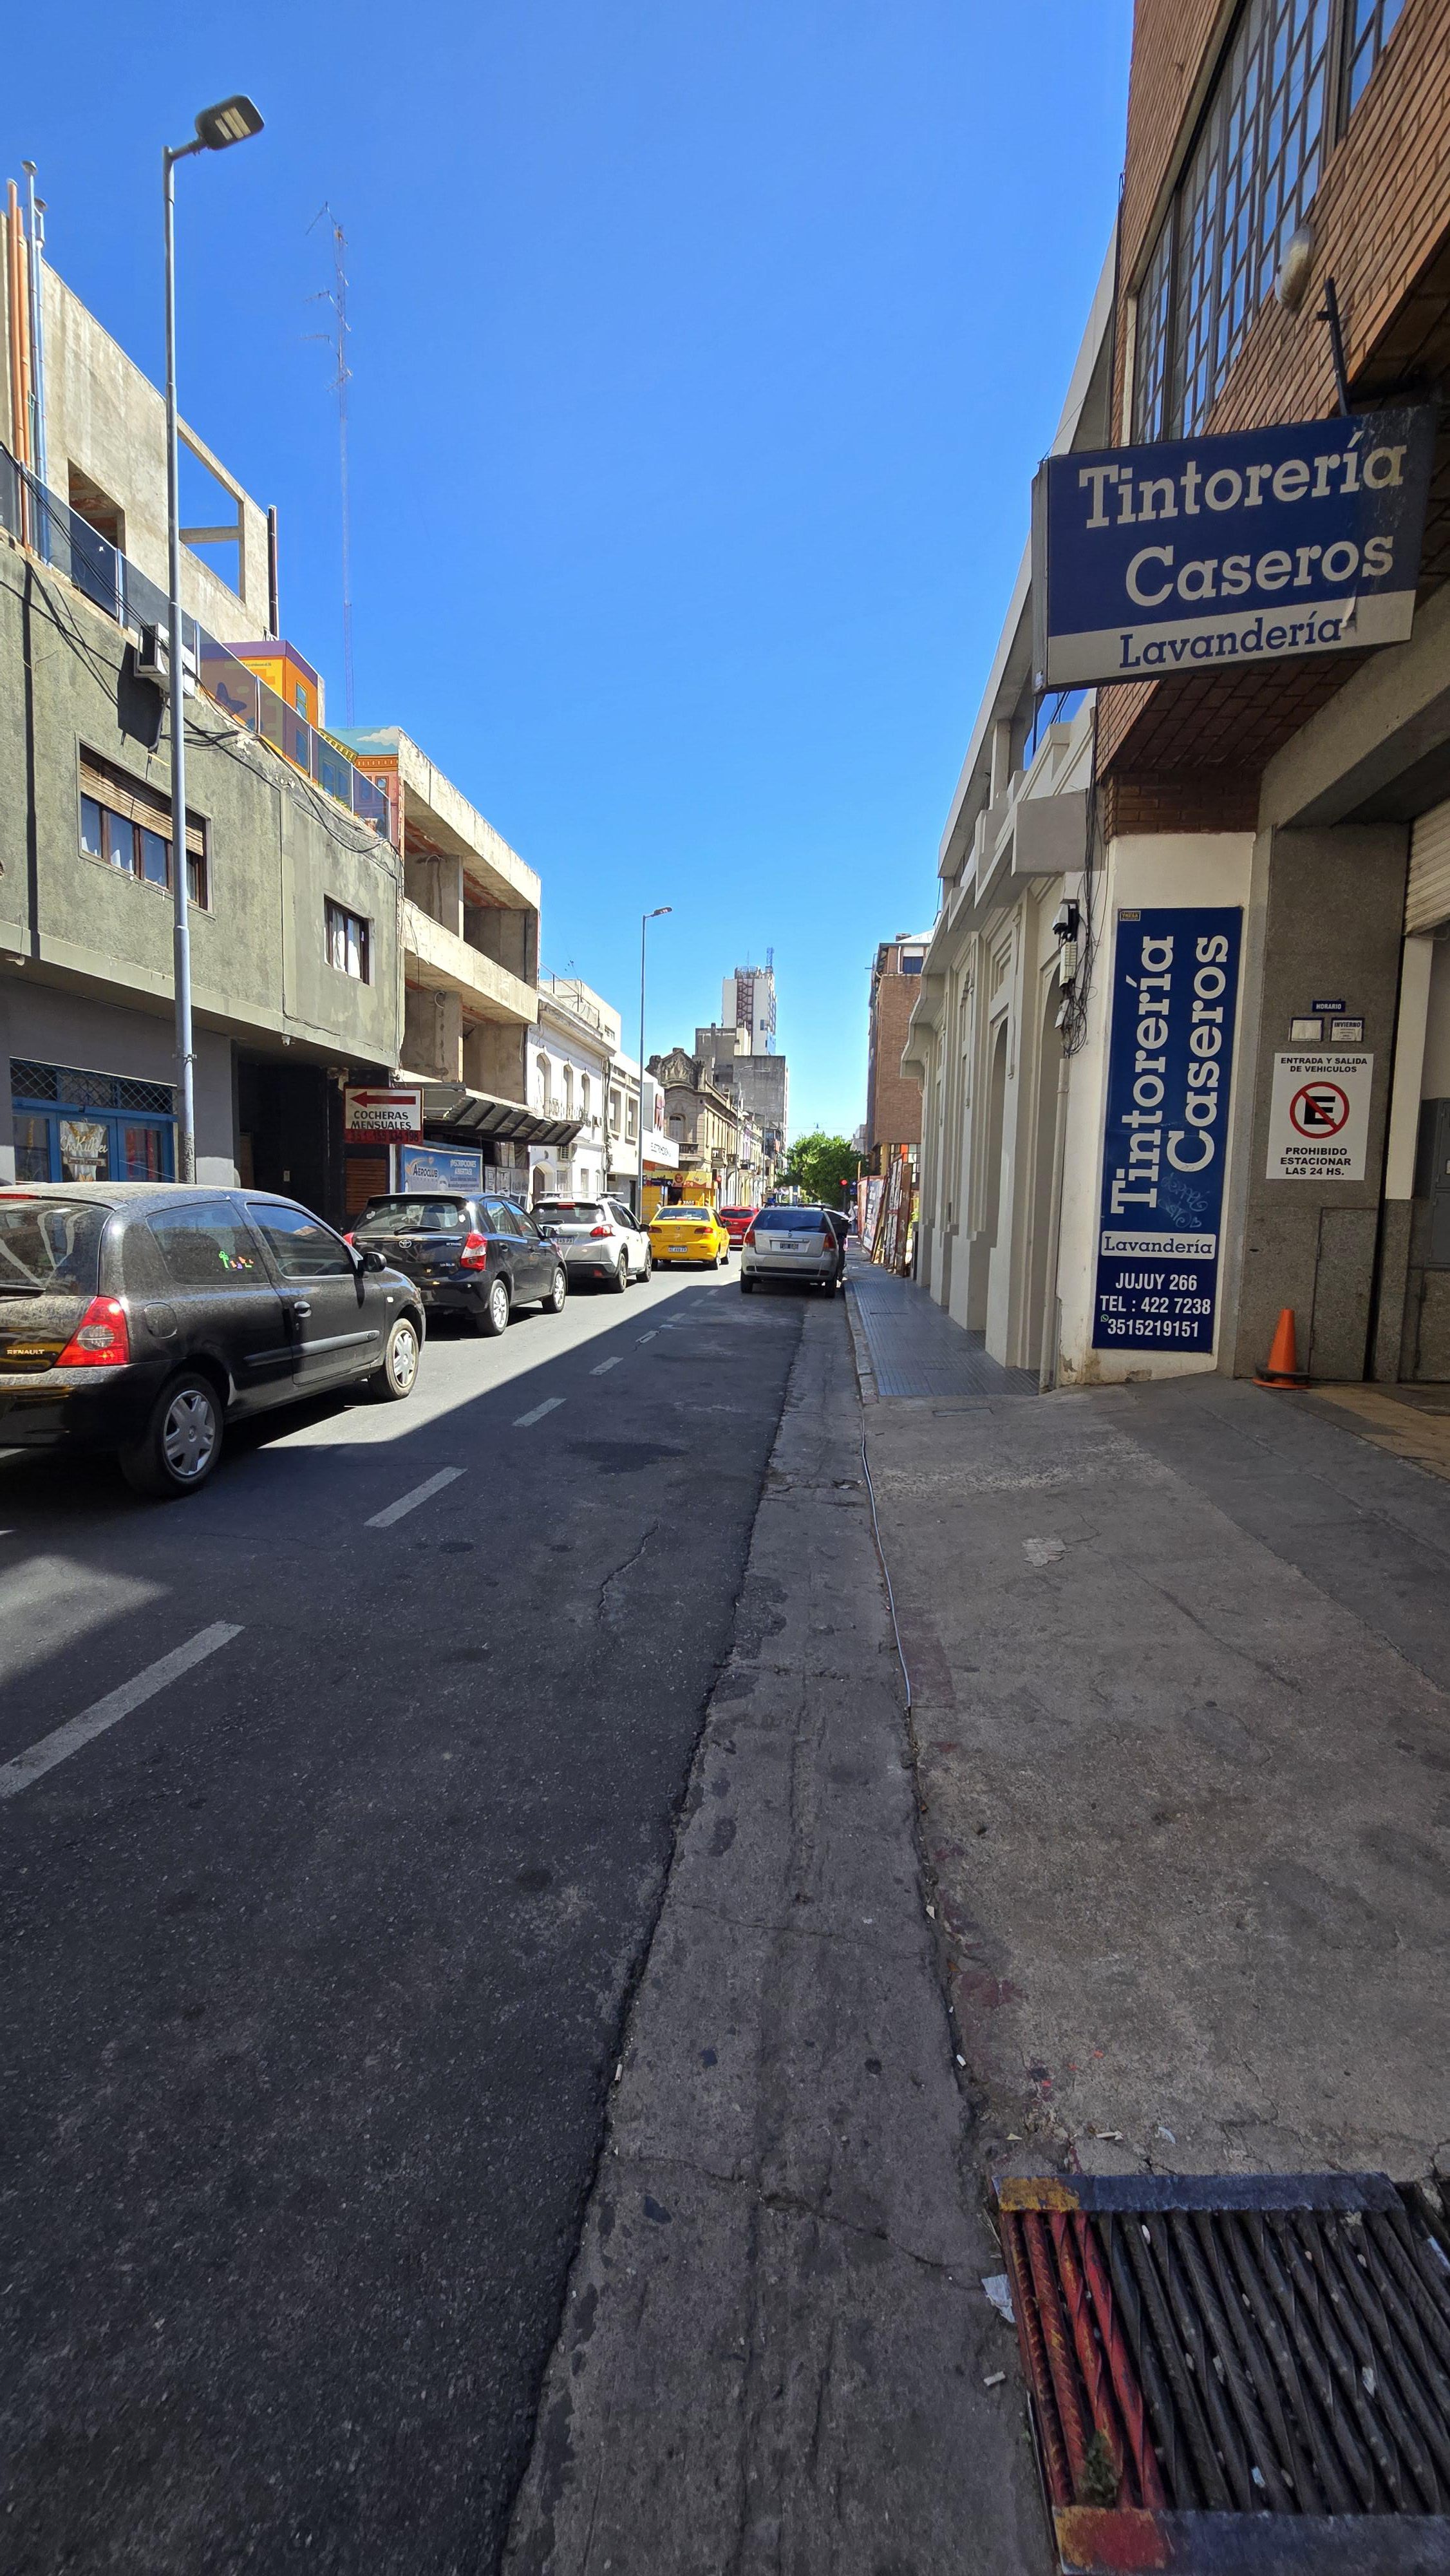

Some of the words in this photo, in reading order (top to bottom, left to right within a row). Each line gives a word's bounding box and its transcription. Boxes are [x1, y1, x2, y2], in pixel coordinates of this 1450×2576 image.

[1079, 431, 1407, 529] Tintorería
[1126, 536, 1393, 607] Caseros
[1120, 611, 1342, 668] Lavandería
[1167, 935, 1229, 1172] Caseros
[1111, 936, 1174, 1213] Tintorería
[354, 1111, 409, 1120] COCHERAS
[351, 1121, 411, 1130] MENSUALES
[1286, 1147, 1348, 1155] PROHIBIDO
[1280, 1157, 1351, 1166] ESTACIONAR
[1104, 1236, 1212, 1254] Lavandería
[1116, 1273, 1165, 1290] JUJUY
[1169, 1274, 1198, 1291] 266
[1100, 1295, 1126, 1312] TEL
[1141, 1296, 1169, 1313] 422
[1174, 1298, 1211, 1314] 7238
[1107, 1318, 1199, 1338] 3515219151
